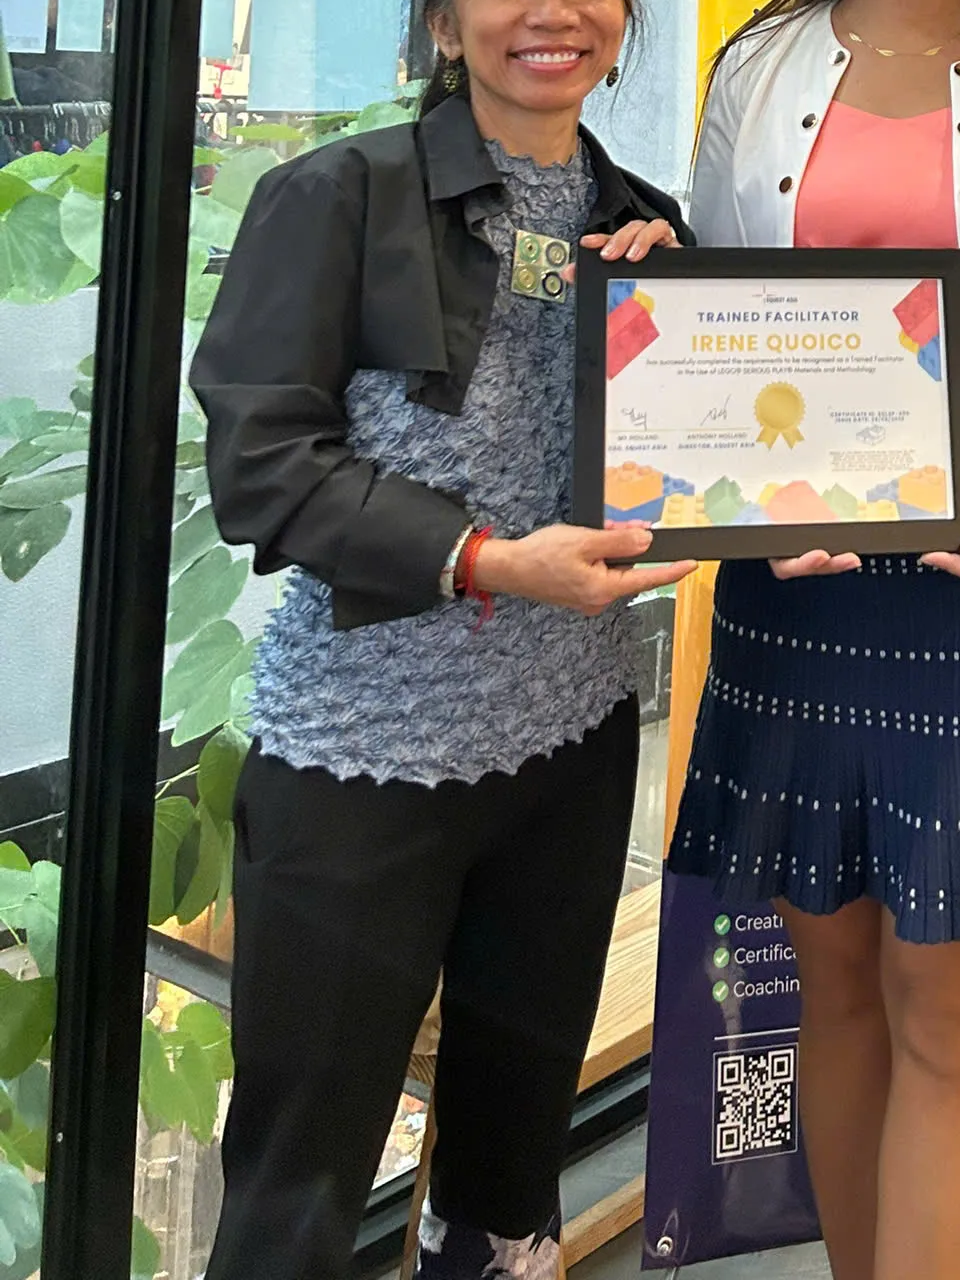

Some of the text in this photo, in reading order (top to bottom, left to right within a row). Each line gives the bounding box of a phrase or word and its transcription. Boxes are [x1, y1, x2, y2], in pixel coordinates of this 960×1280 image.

[697, 311, 859, 322] TRAINED FACILITATOR
[692, 333, 861, 353] IRENE QUOICO
[734, 944, 797, 965] Certific
[733, 975, 800, 998] Coachin
